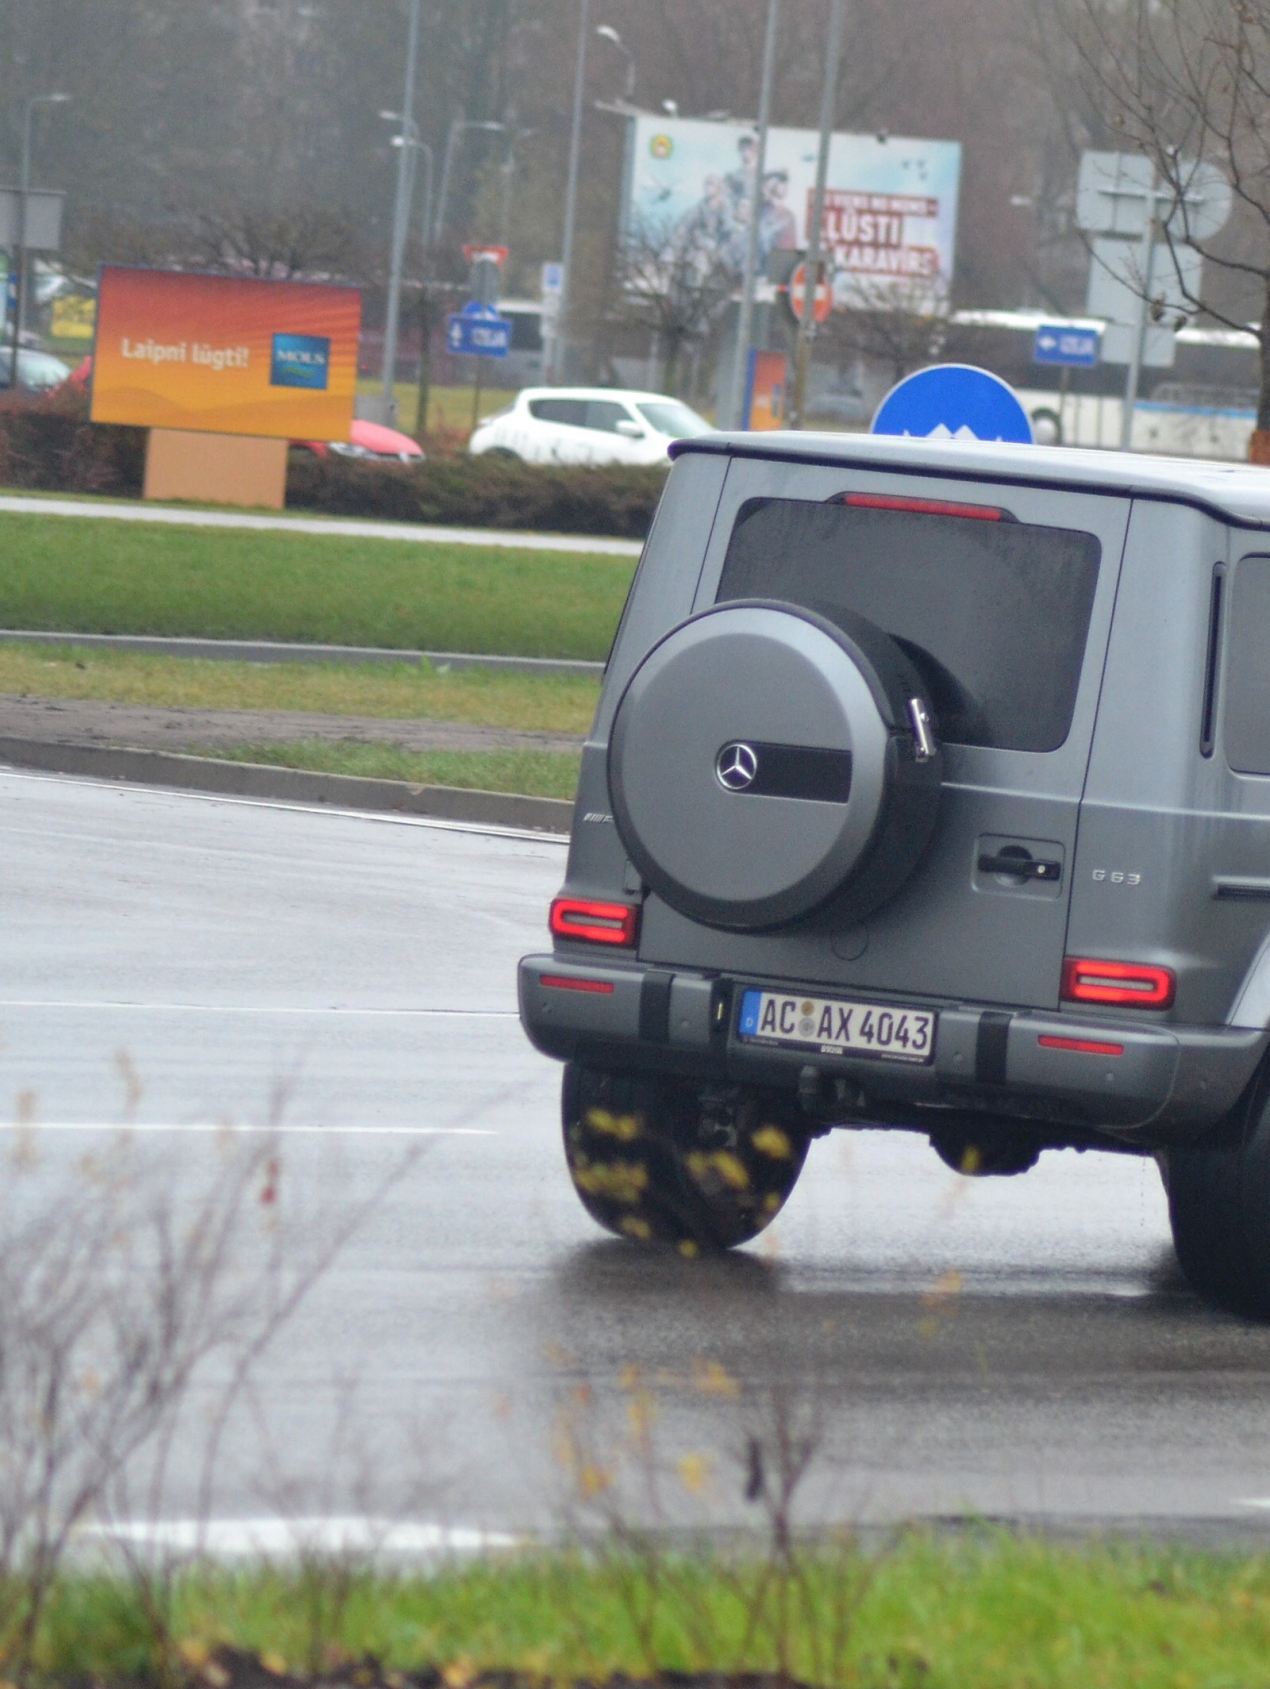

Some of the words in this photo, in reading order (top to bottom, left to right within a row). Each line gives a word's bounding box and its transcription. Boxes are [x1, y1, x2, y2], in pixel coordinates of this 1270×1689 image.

[121, 338, 186, 364] Laipni
[277, 349, 326, 366] MOLS
[1092, 869, 1106, 881] G
[1110, 871, 1141, 886] 63
[760, 999, 797, 1034] AC
[816, 1005, 854, 1042] AX
[859, 1010, 931, 1051] 4043
